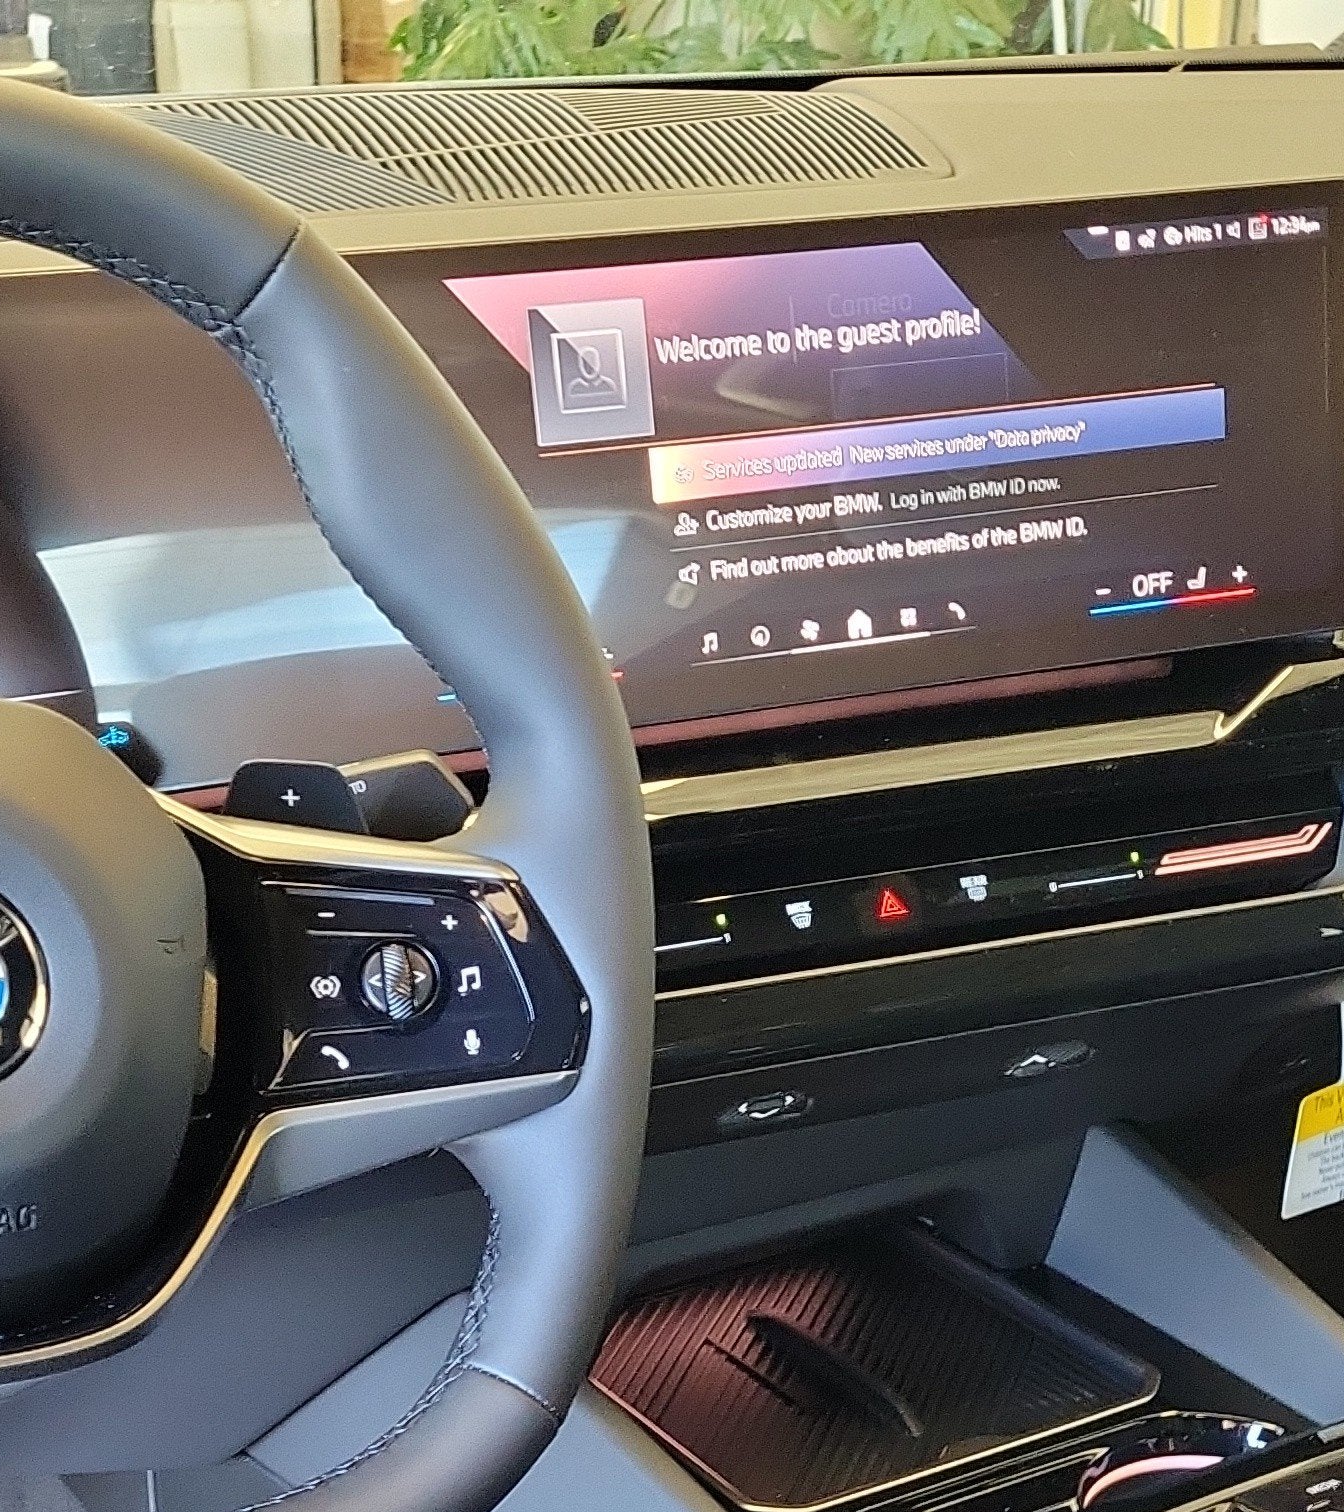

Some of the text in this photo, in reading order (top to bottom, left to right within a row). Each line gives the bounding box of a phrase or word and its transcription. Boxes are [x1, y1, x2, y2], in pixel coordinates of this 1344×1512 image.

[654, 308, 981, 364] Welcome to the guest profile!
[703, 421, 1086, 481] Services updated New services under "Data privacy"
[706, 475, 1061, 533] Customize your BMW. Log in with BMW ID now.
[710, 516, 1088, 582] Find out more about the benefits of the BMW ID.
[1132, 571, 1174, 597] OFF
[1314, 1096, 1335, 1113] This
[1324, 1129, 1344, 1145] Even
